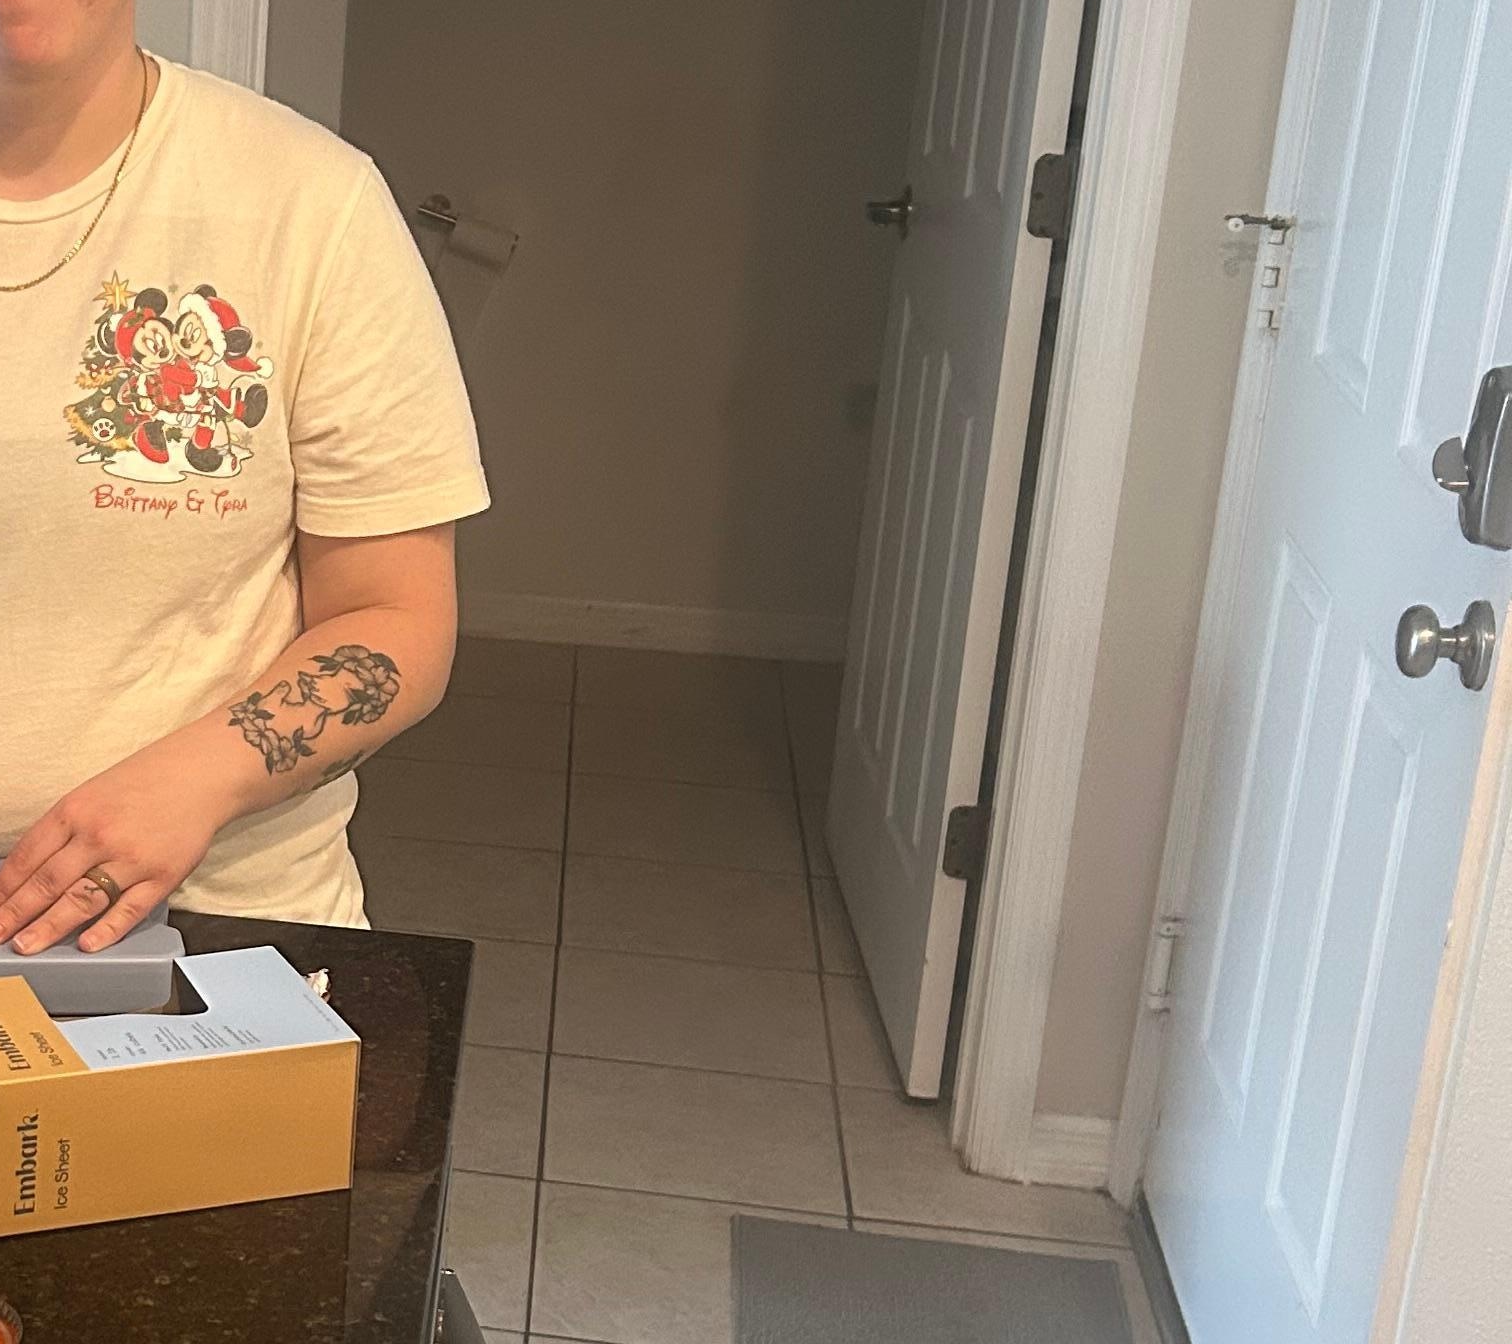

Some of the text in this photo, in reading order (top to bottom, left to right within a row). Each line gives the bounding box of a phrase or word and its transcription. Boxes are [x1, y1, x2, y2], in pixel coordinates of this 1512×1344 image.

[187, 489, 205, 513] &
[29, 1031, 64, 1068] Ice Sheet
[13, 1113, 40, 1216] Embark
[53, 1137, 72, 1210] Ice Sheet
